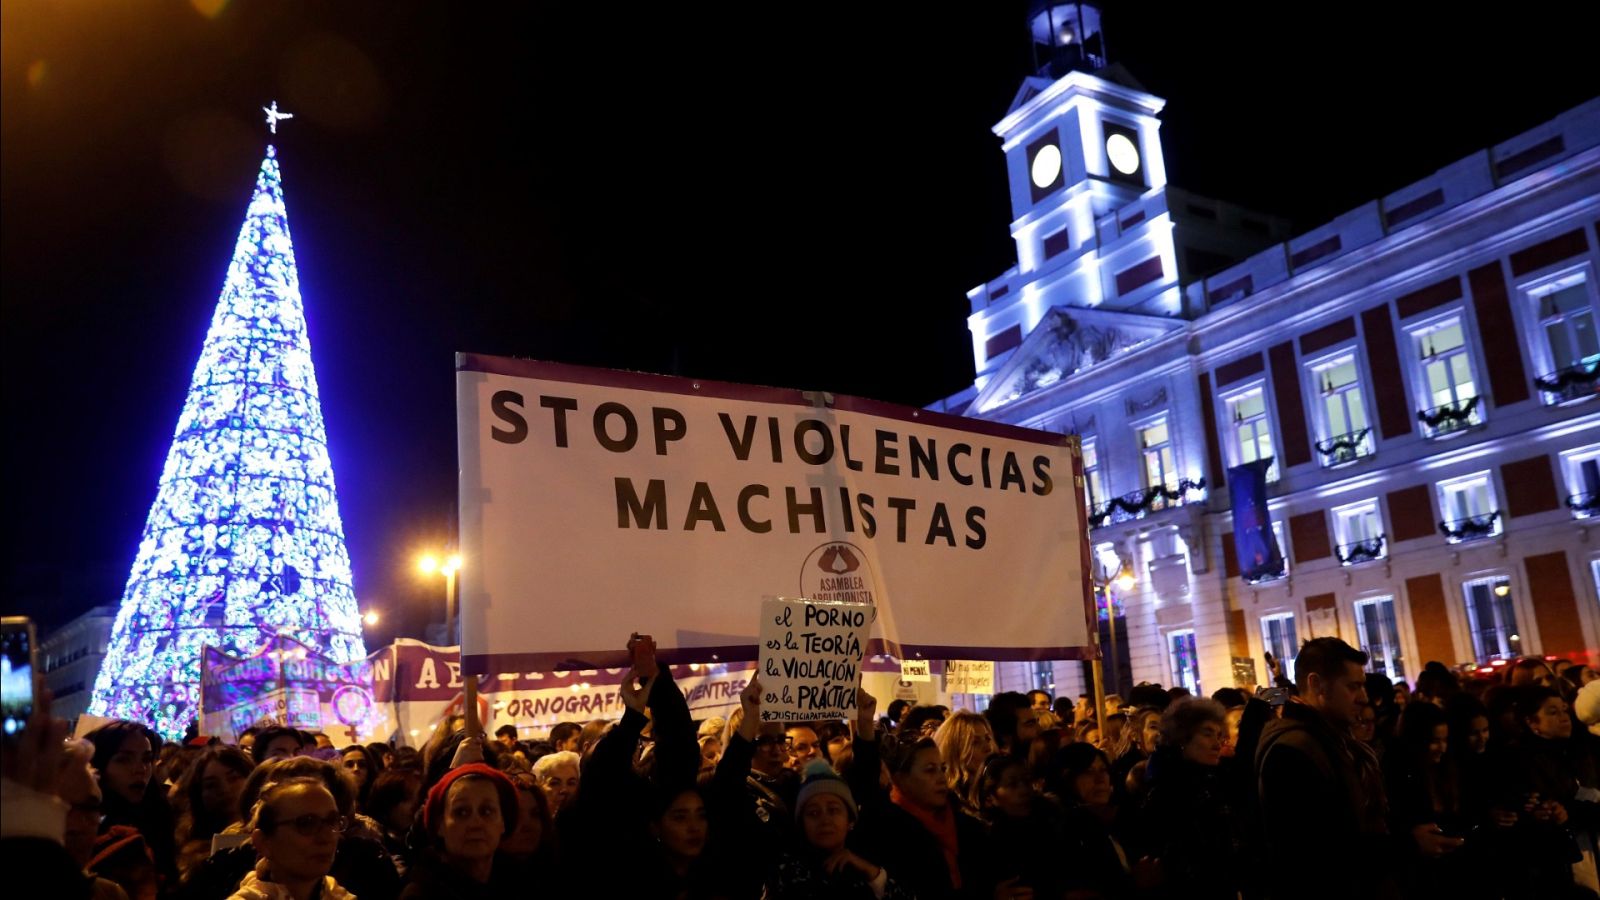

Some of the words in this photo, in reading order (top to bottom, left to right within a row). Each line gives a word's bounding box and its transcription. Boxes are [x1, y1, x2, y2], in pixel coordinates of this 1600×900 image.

[491, 390, 688, 456] STOP
[718, 412, 1052, 497] VIOLENCIAS
[614, 477, 988, 550] MACHISTAS
[820, 577, 864, 591] ASAMBLEA
[775, 606, 792, 627] el
[805, 604, 864, 627] PORNO
[767, 640, 781, 650] es
[784, 631, 799, 650] la
[801, 632, 863, 661] TEORÍA,
[766, 658, 780, 676] la
[783, 658, 856, 682] VIOLACIÓN
[493, 687, 623, 719] PORNOGRAFÍ
[685, 680, 746, 699] VIENTRES
[765, 693, 778, 704] es
[782, 685, 794, 704] la
[798, 681, 857, 710] PRÁCTICA
